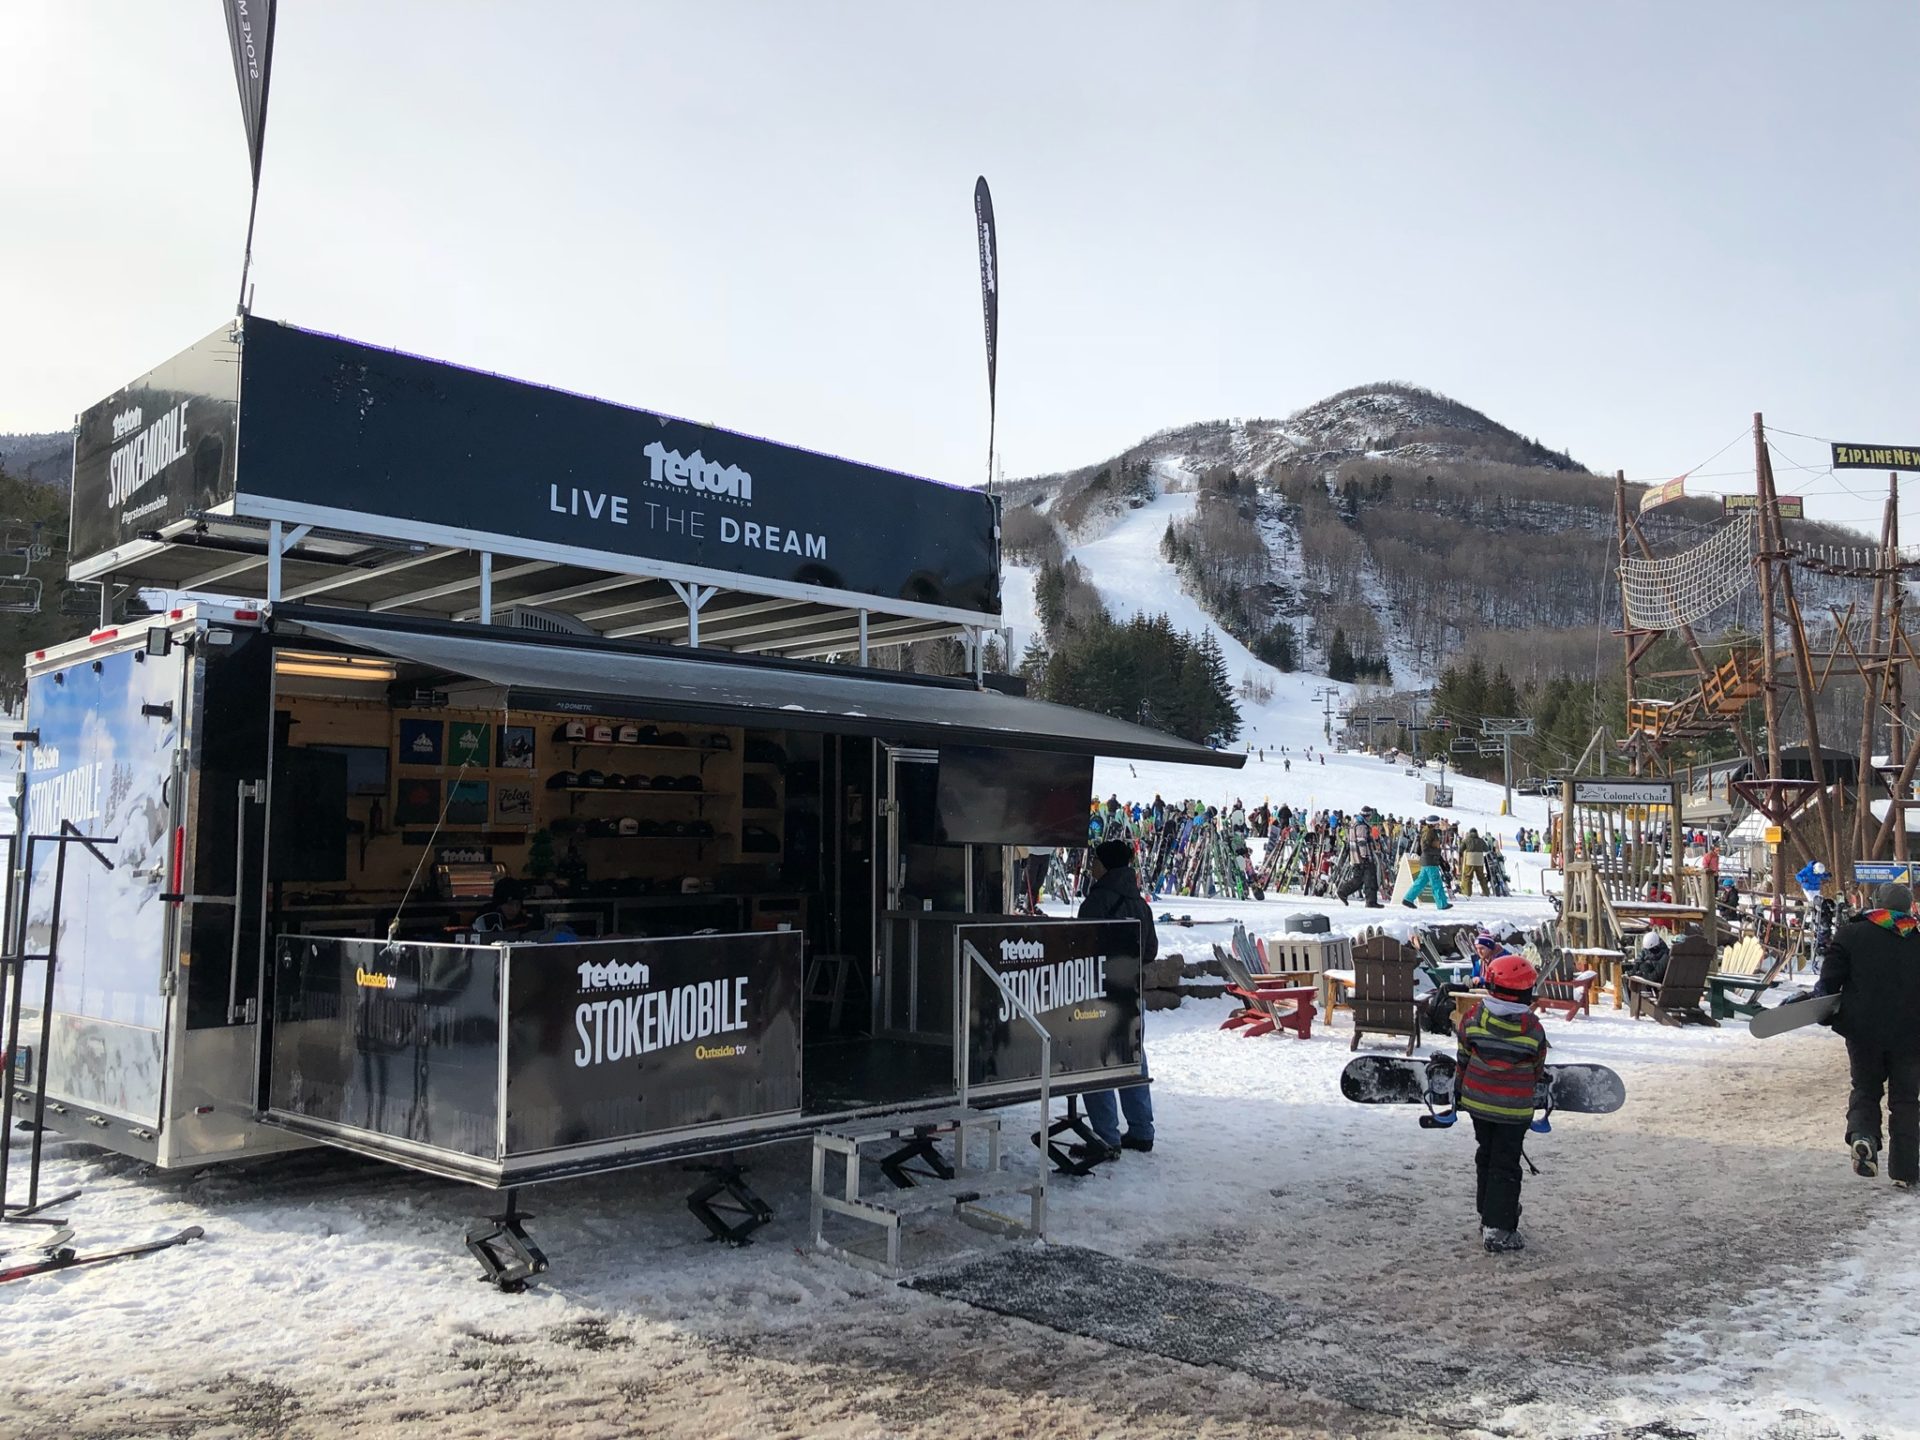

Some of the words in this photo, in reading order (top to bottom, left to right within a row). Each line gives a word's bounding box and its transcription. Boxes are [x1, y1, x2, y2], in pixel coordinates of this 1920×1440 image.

[108, 401, 189, 509] STOKEMOBILE
[550, 483, 629, 524] LIVE
[644, 501, 705, 539] THE
[719, 516, 828, 560] DREAM
[642, 480, 689, 494] GRAVITY
[696, 492, 752, 507] RESEARCH
[28, 762, 103, 836] STOKEMOBILE
[1603, 791, 1641, 801] Colonel's
[1642, 792, 1667, 801] Chair
[356, 967, 387, 988] Outside
[999, 956, 1107, 1023] STOKEMOBILE
[574, 976, 749, 1068] STOKEMOBILE
[695, 1045, 735, 1060] Outside
[735, 1044, 747, 1056] tv
